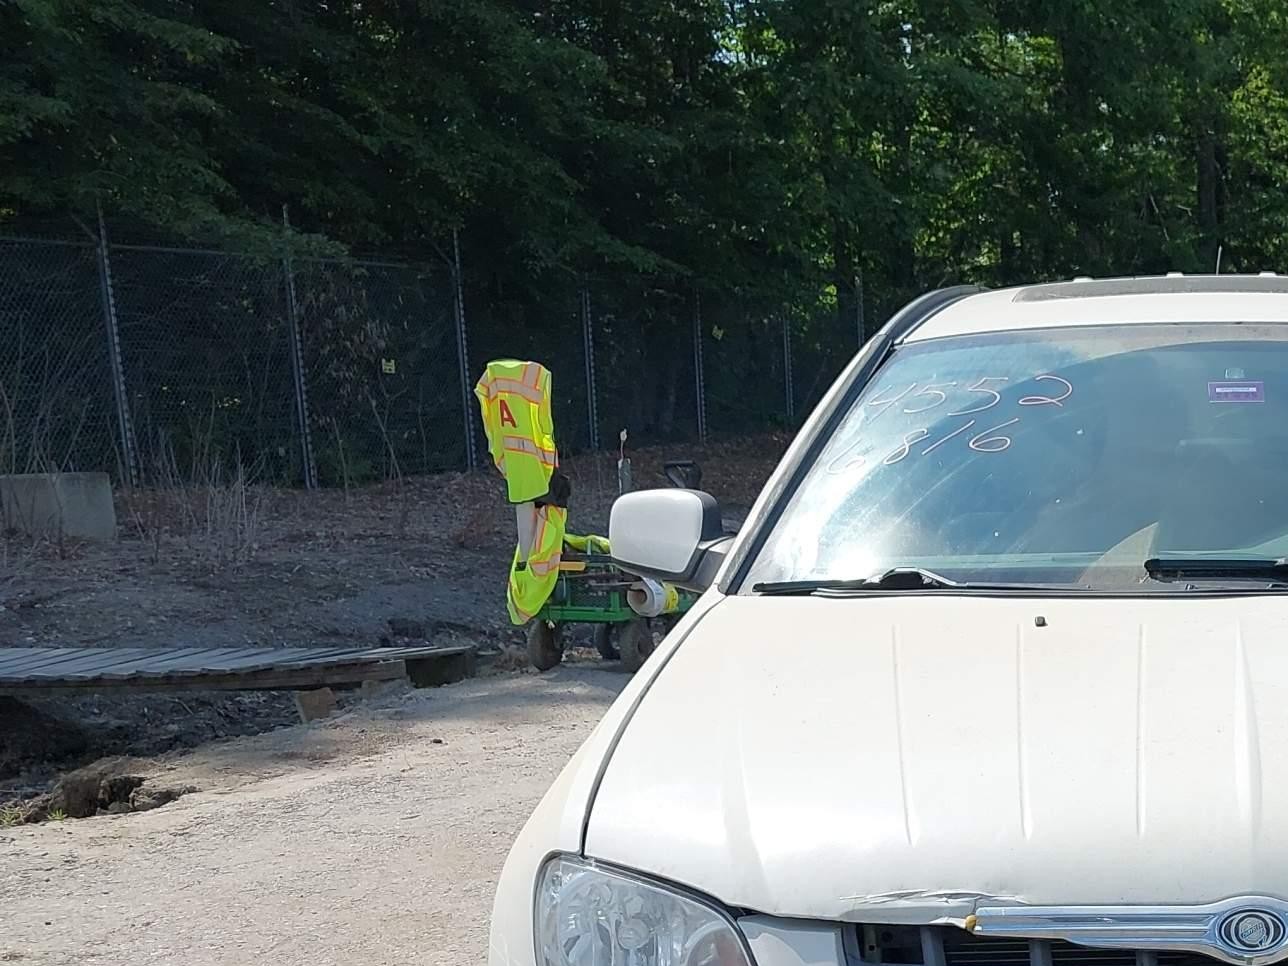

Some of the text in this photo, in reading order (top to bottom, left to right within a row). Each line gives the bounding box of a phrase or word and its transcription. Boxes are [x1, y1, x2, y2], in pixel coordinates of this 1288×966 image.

[499, 399, 517, 428] A
[867, 375, 1073, 425] 4552
[827, 417, 1020, 475] 6816
